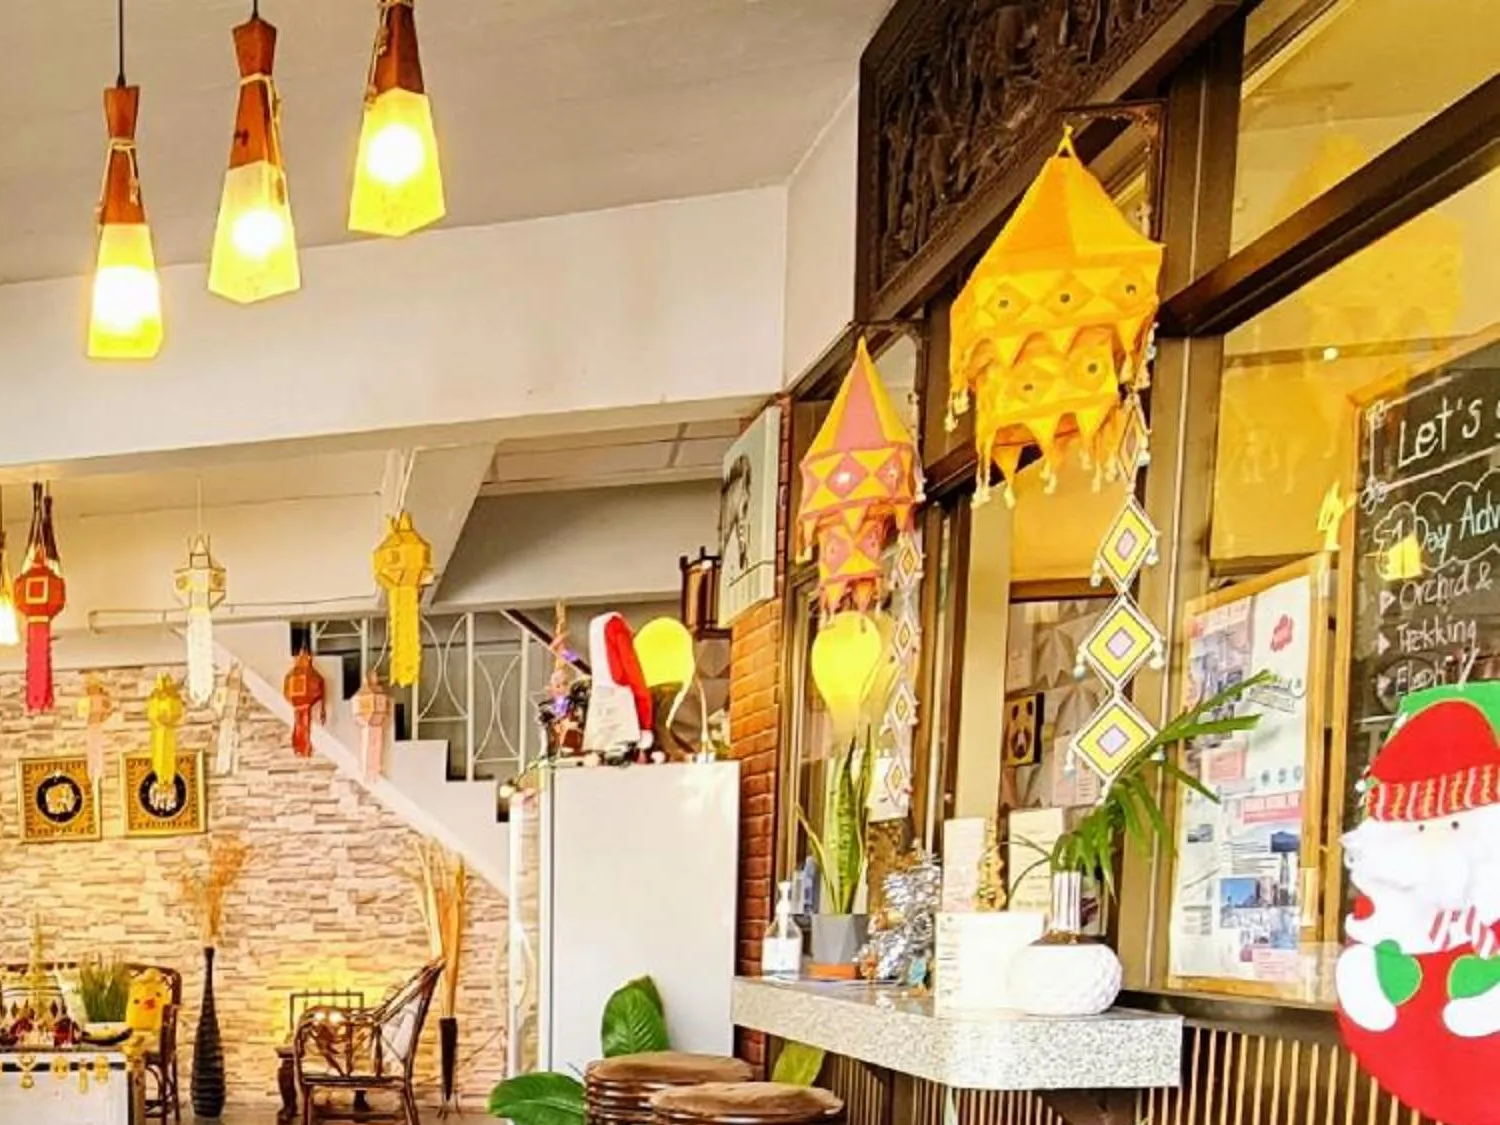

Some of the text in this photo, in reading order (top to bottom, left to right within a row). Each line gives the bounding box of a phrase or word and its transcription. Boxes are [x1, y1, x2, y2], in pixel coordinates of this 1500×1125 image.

[1399, 397, 1483, 467] Let's
[1400, 561, 1493, 611] Orchid &
